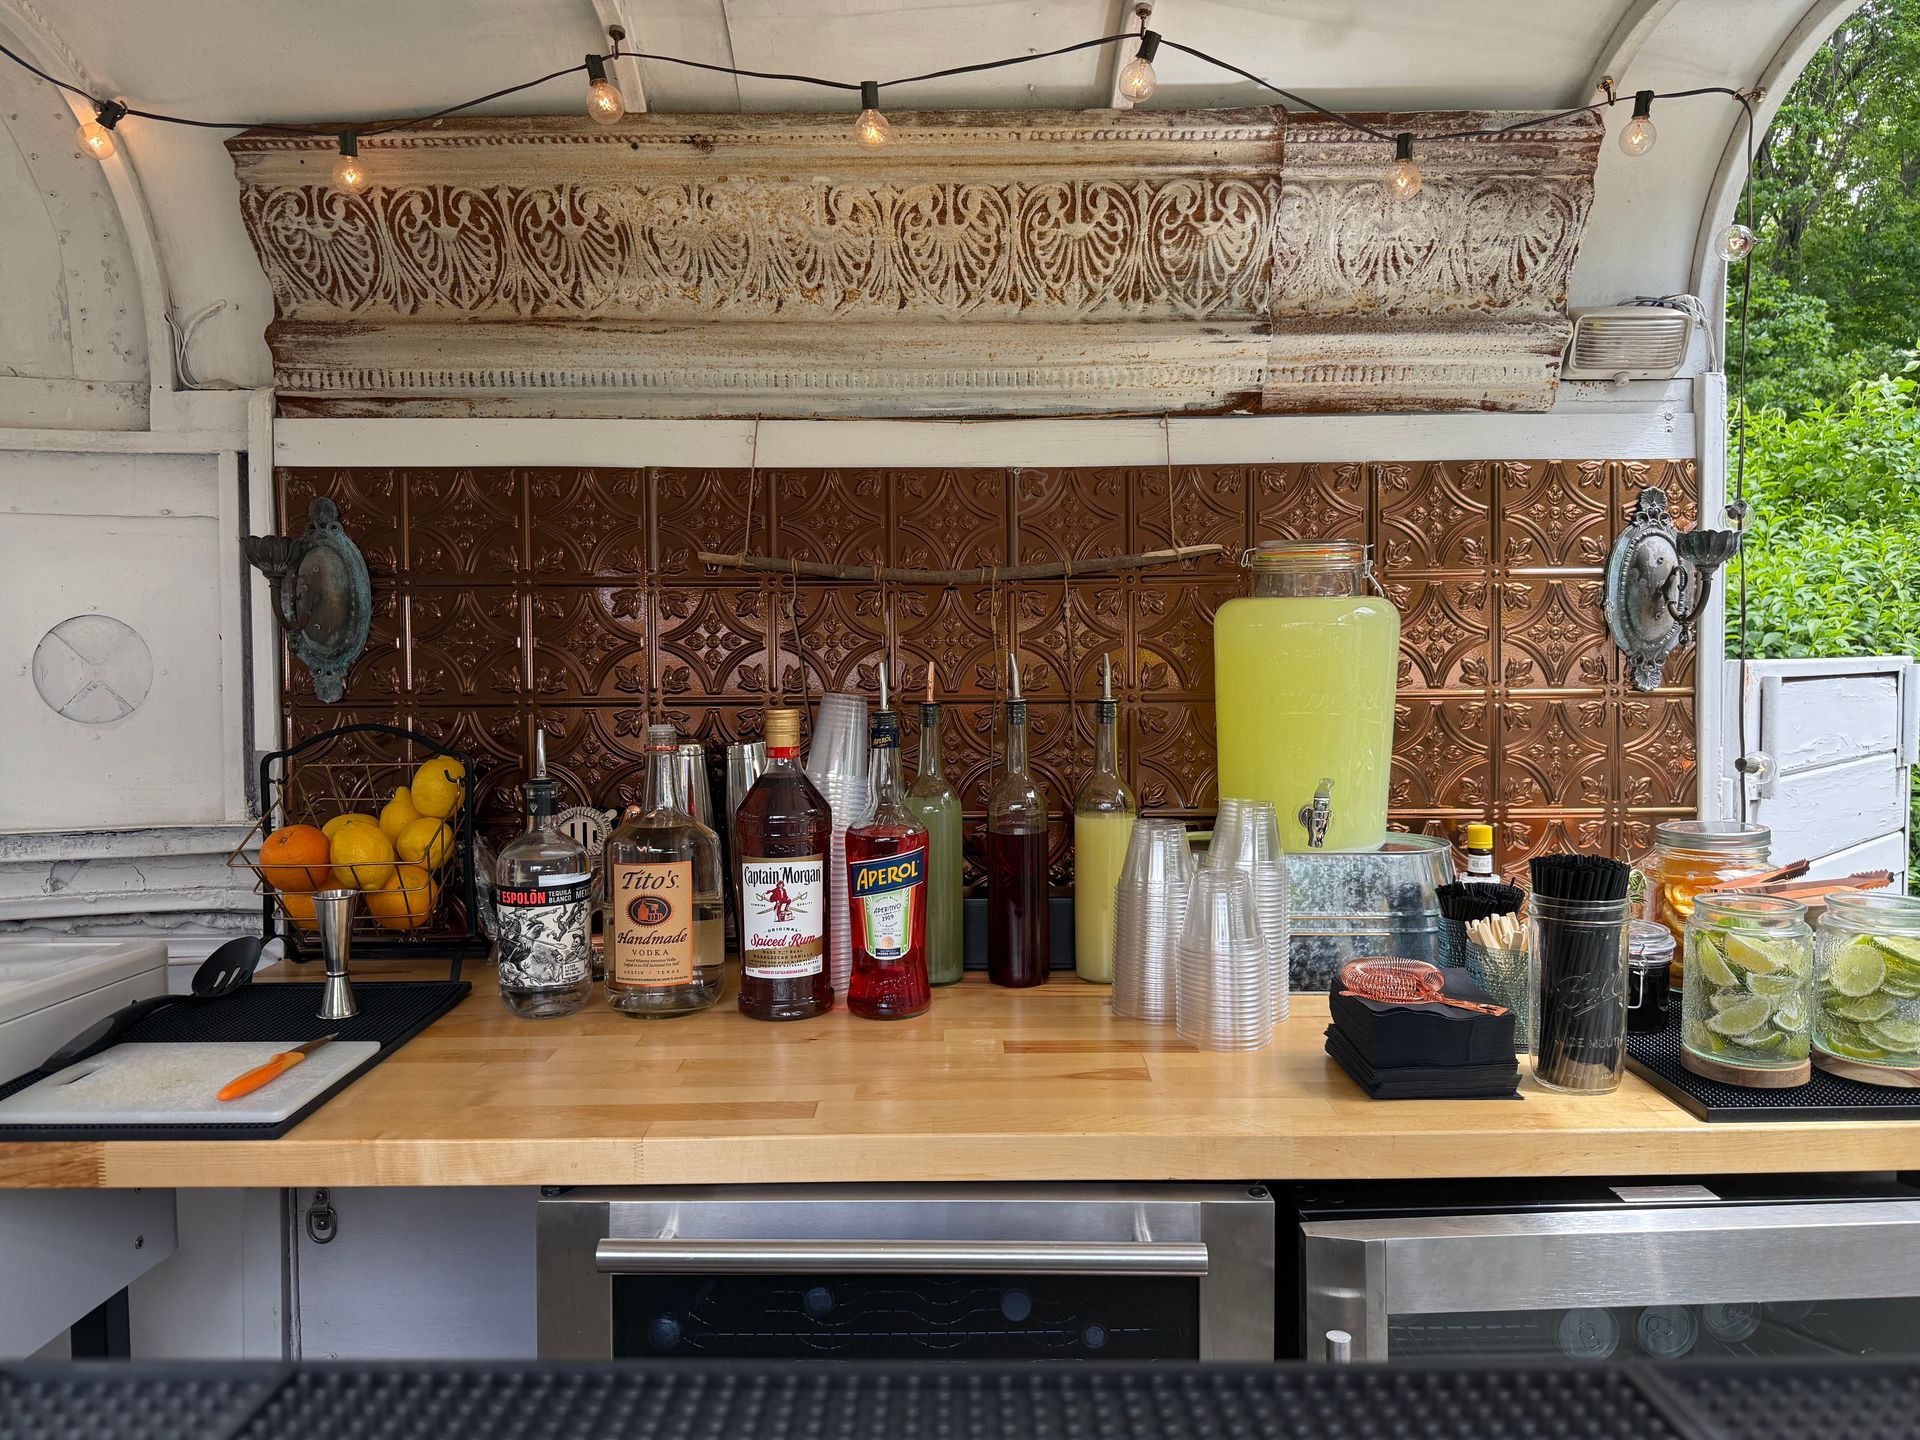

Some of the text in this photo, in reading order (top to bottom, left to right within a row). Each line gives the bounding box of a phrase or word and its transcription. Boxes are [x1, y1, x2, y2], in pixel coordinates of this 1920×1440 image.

[622, 869, 679, 889] Tito's
[744, 866, 821, 887] Captain Morgan
[857, 860, 919, 891] APEROL
[548, 888, 572, 896] TEQUILA
[548, 895, 572, 903] BLANCO
[617, 928, 688, 945] Handmade
[750, 932, 817, 947] Spiced Rum
